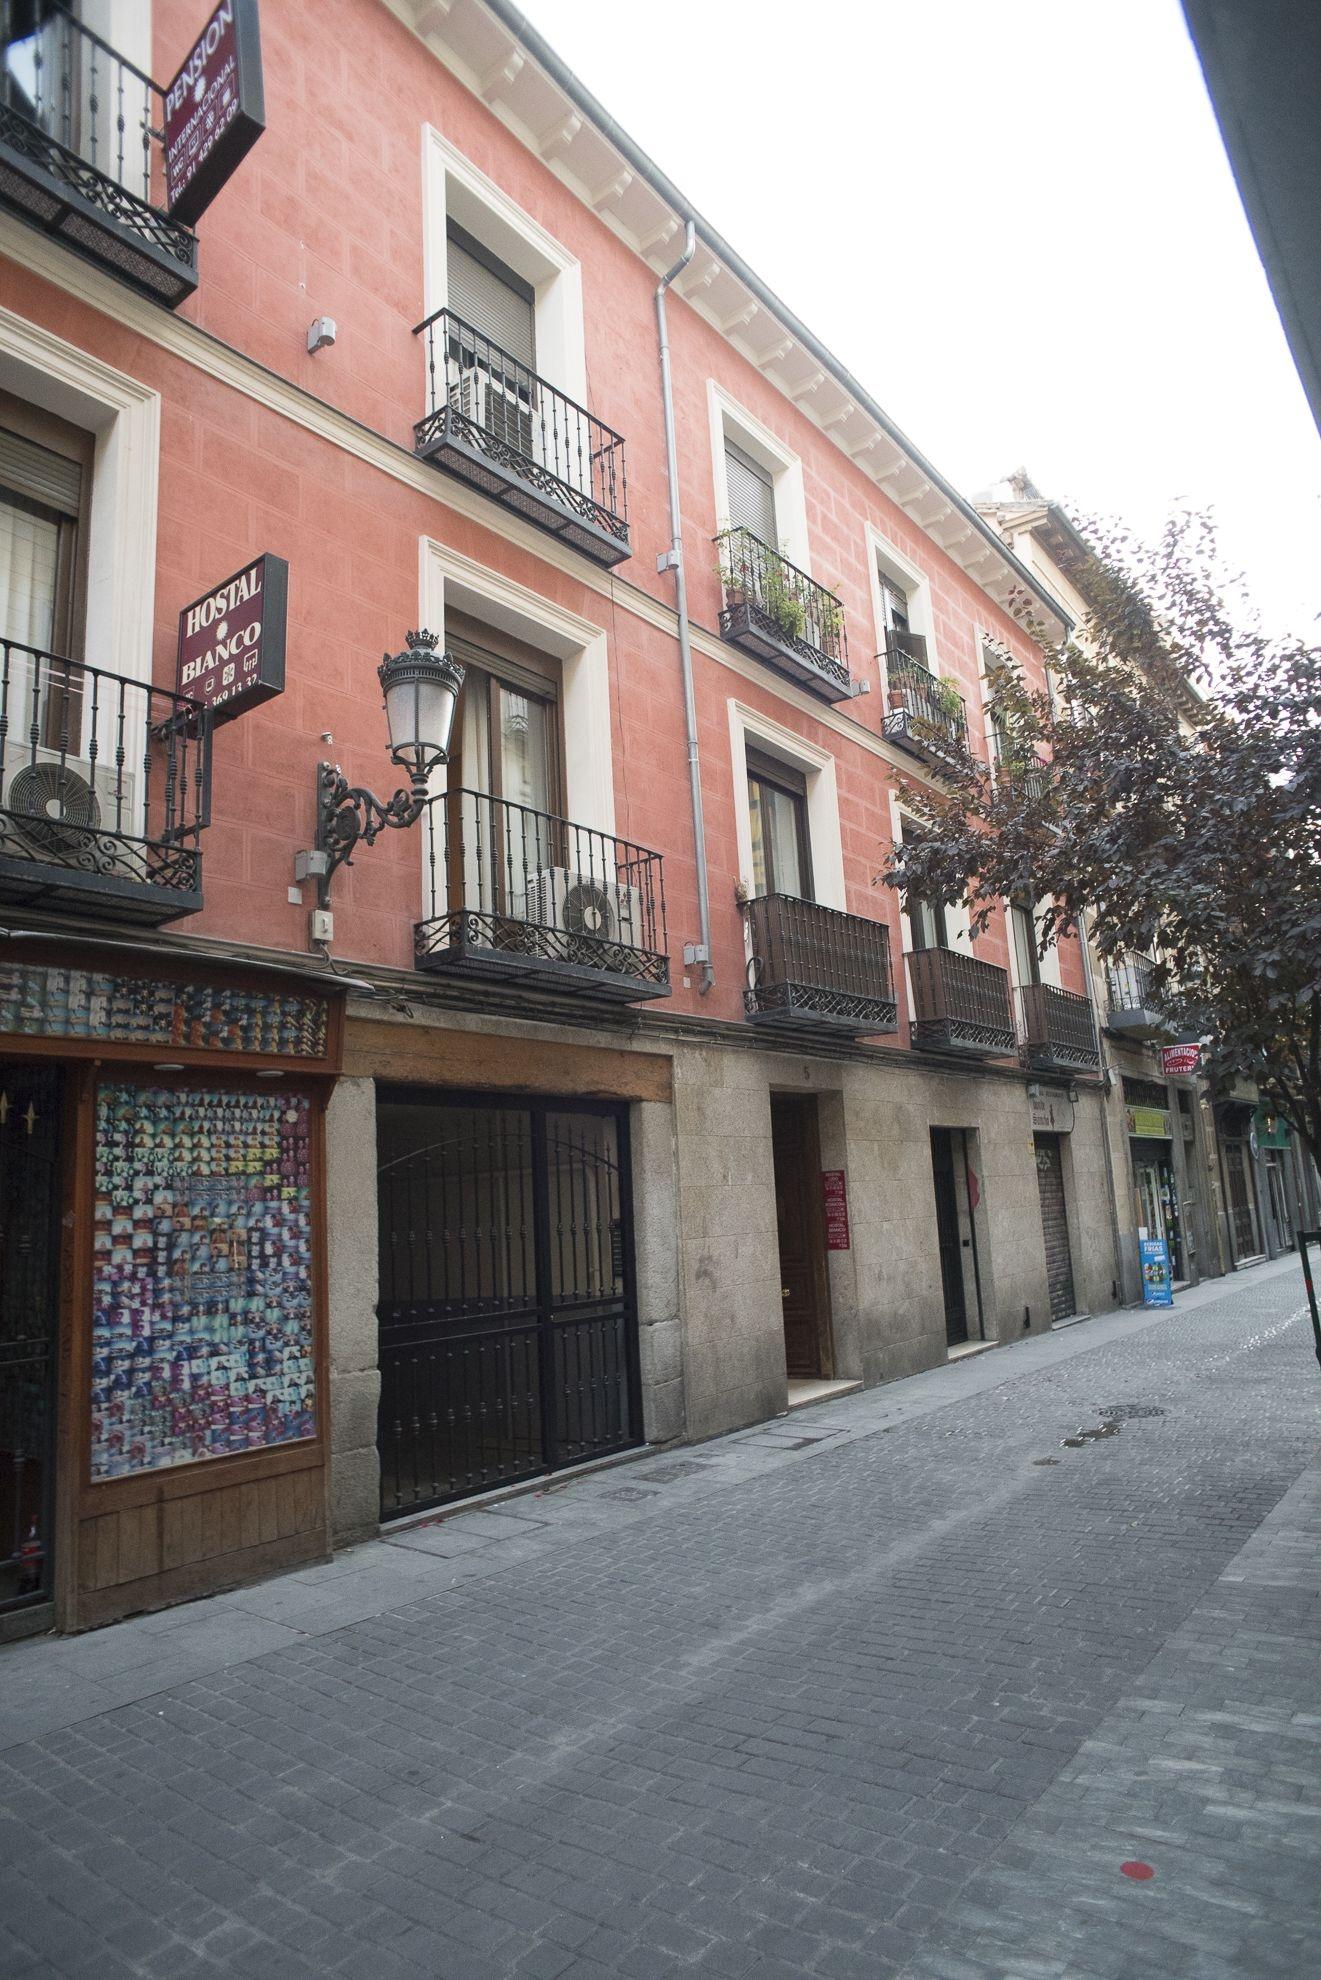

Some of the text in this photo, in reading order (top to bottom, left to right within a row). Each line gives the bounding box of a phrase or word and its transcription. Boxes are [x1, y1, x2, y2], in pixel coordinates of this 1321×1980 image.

[166, 0, 233, 122] PENSION
[168, 55, 236, 162] INTERNACIONAL
[187, 160, 196, 181] 91
[199, 135, 214, 161] 429
[214, 117, 225, 140] 62
[227, 98, 238, 122] 09
[173, 157, 184, 177] WC
[186, 567, 262, 639] HOSTAL
[181, 621, 262, 686] BIANCO
[1165, 1065, 1194, 1073] FRUTER
